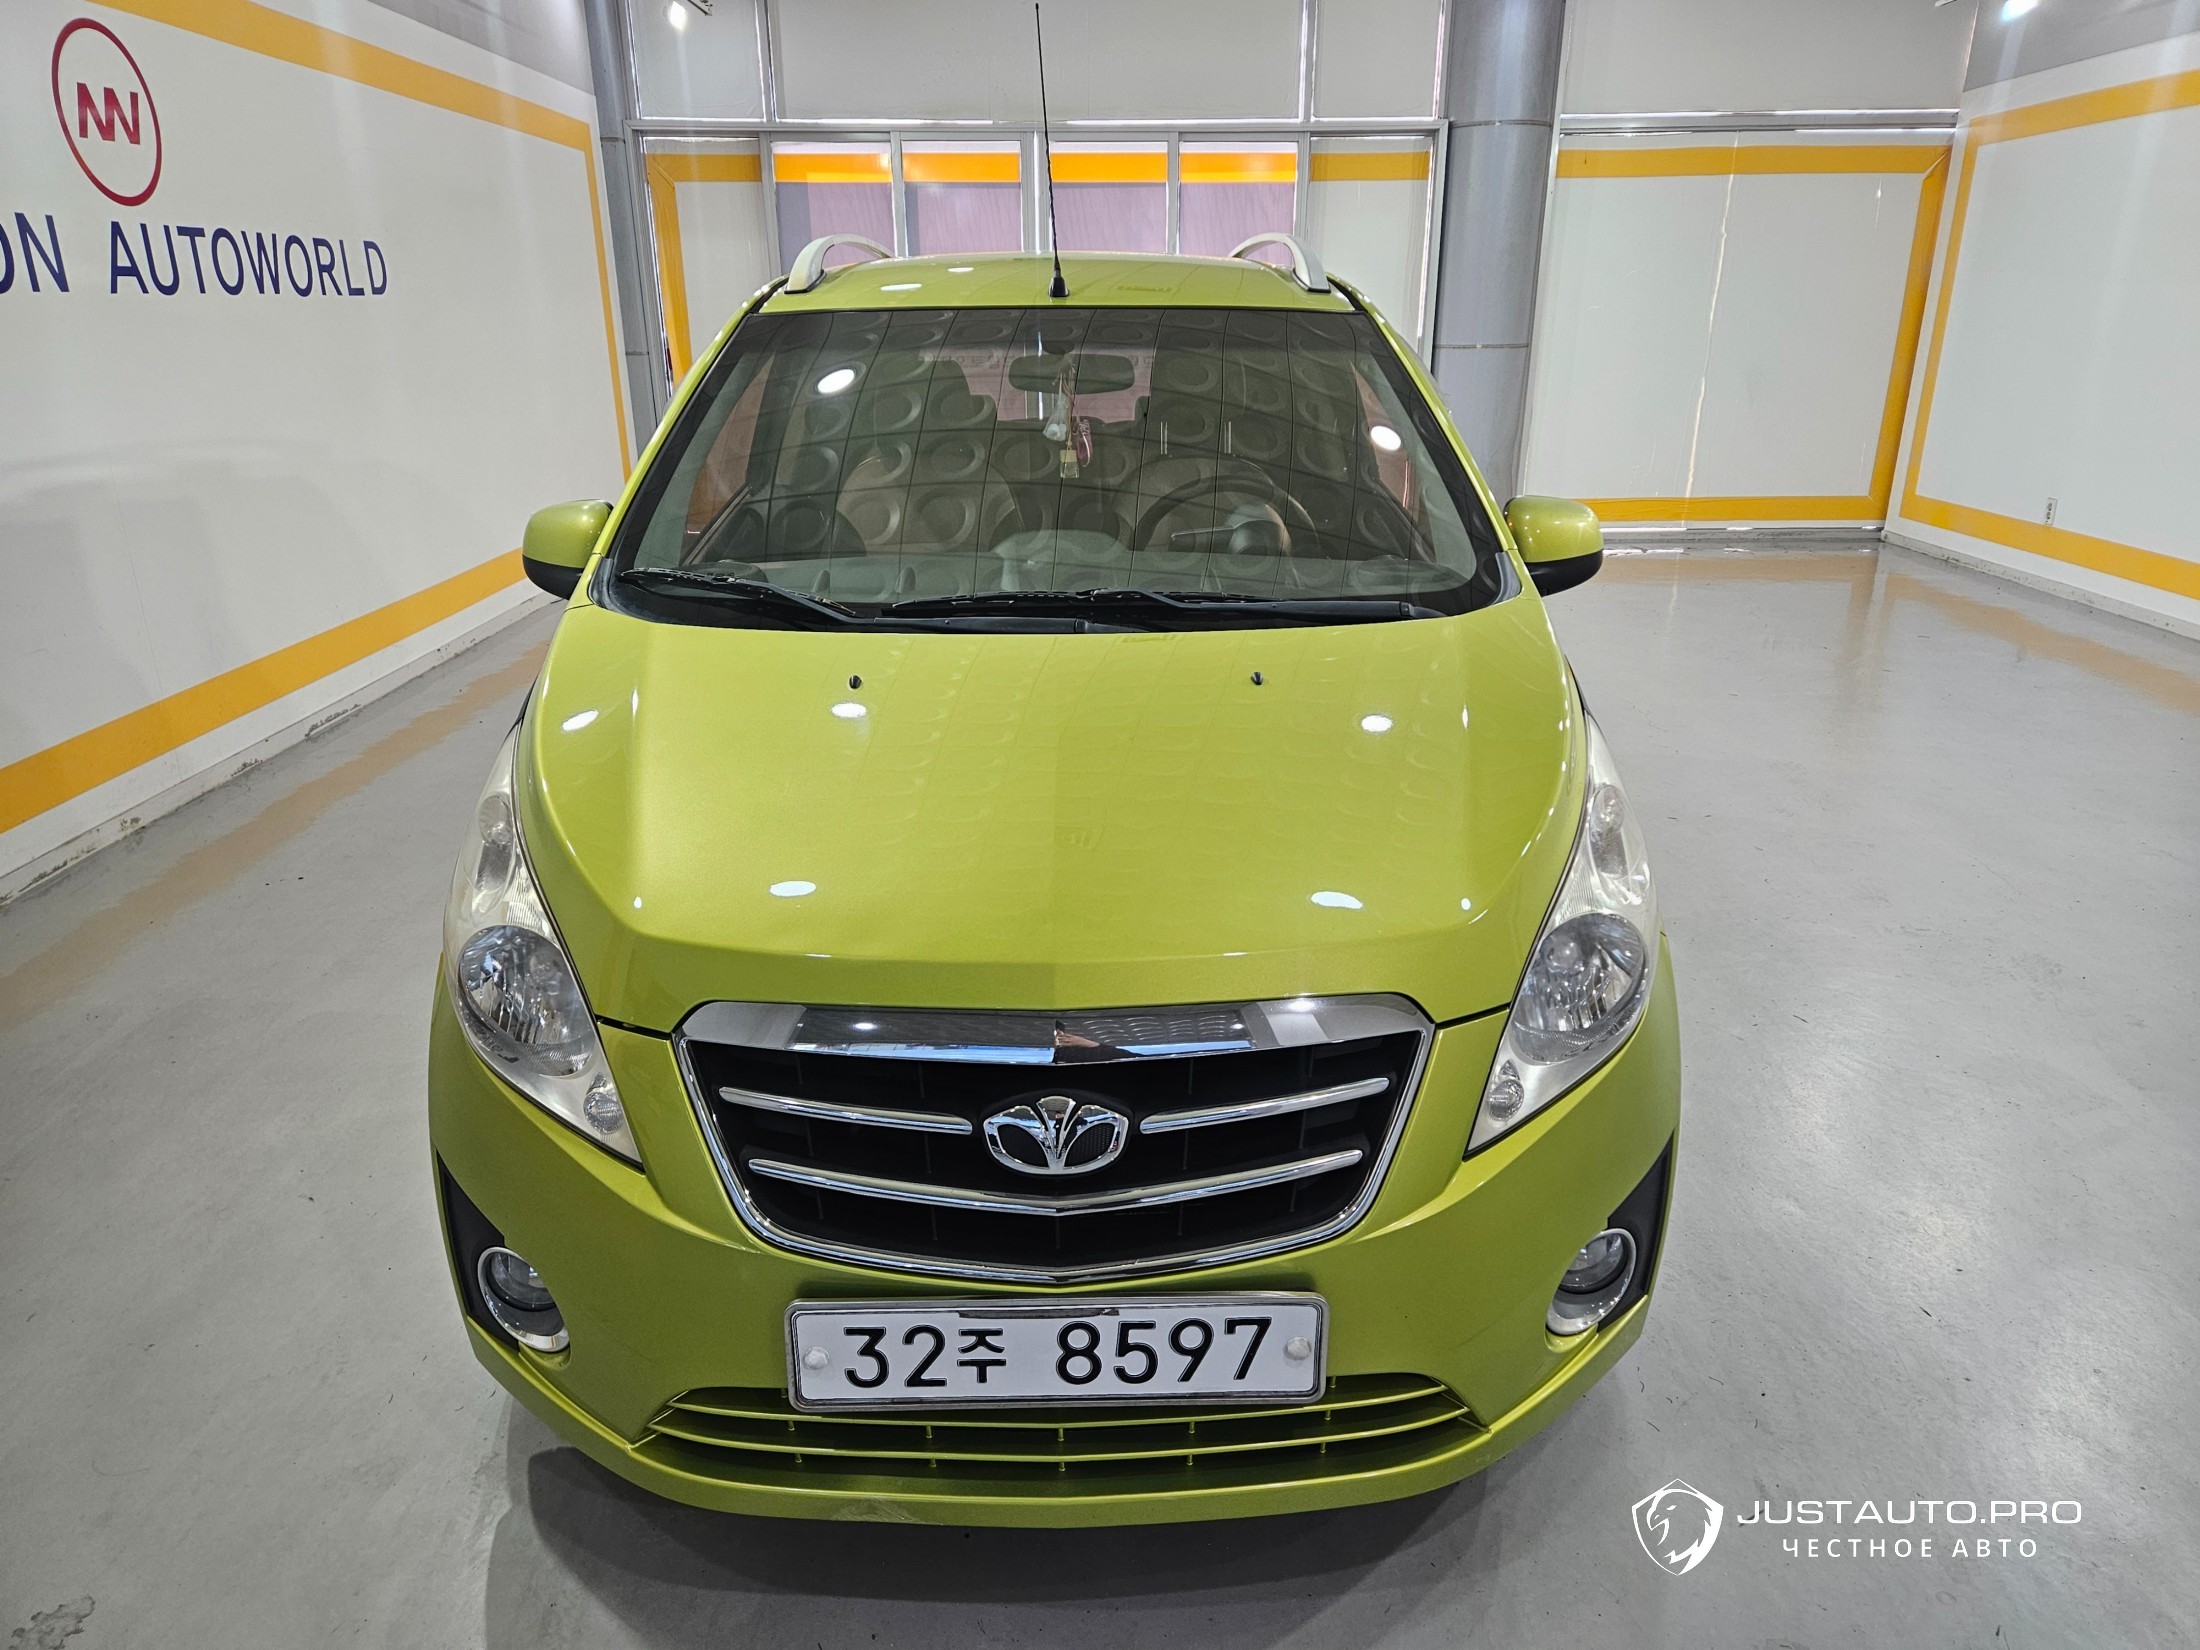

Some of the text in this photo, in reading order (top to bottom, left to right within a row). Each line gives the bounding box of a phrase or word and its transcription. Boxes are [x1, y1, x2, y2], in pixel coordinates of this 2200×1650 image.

[110, 220, 388, 297] AUTOWORLD
[843, 1317, 1273, 1389] 32주 8597
